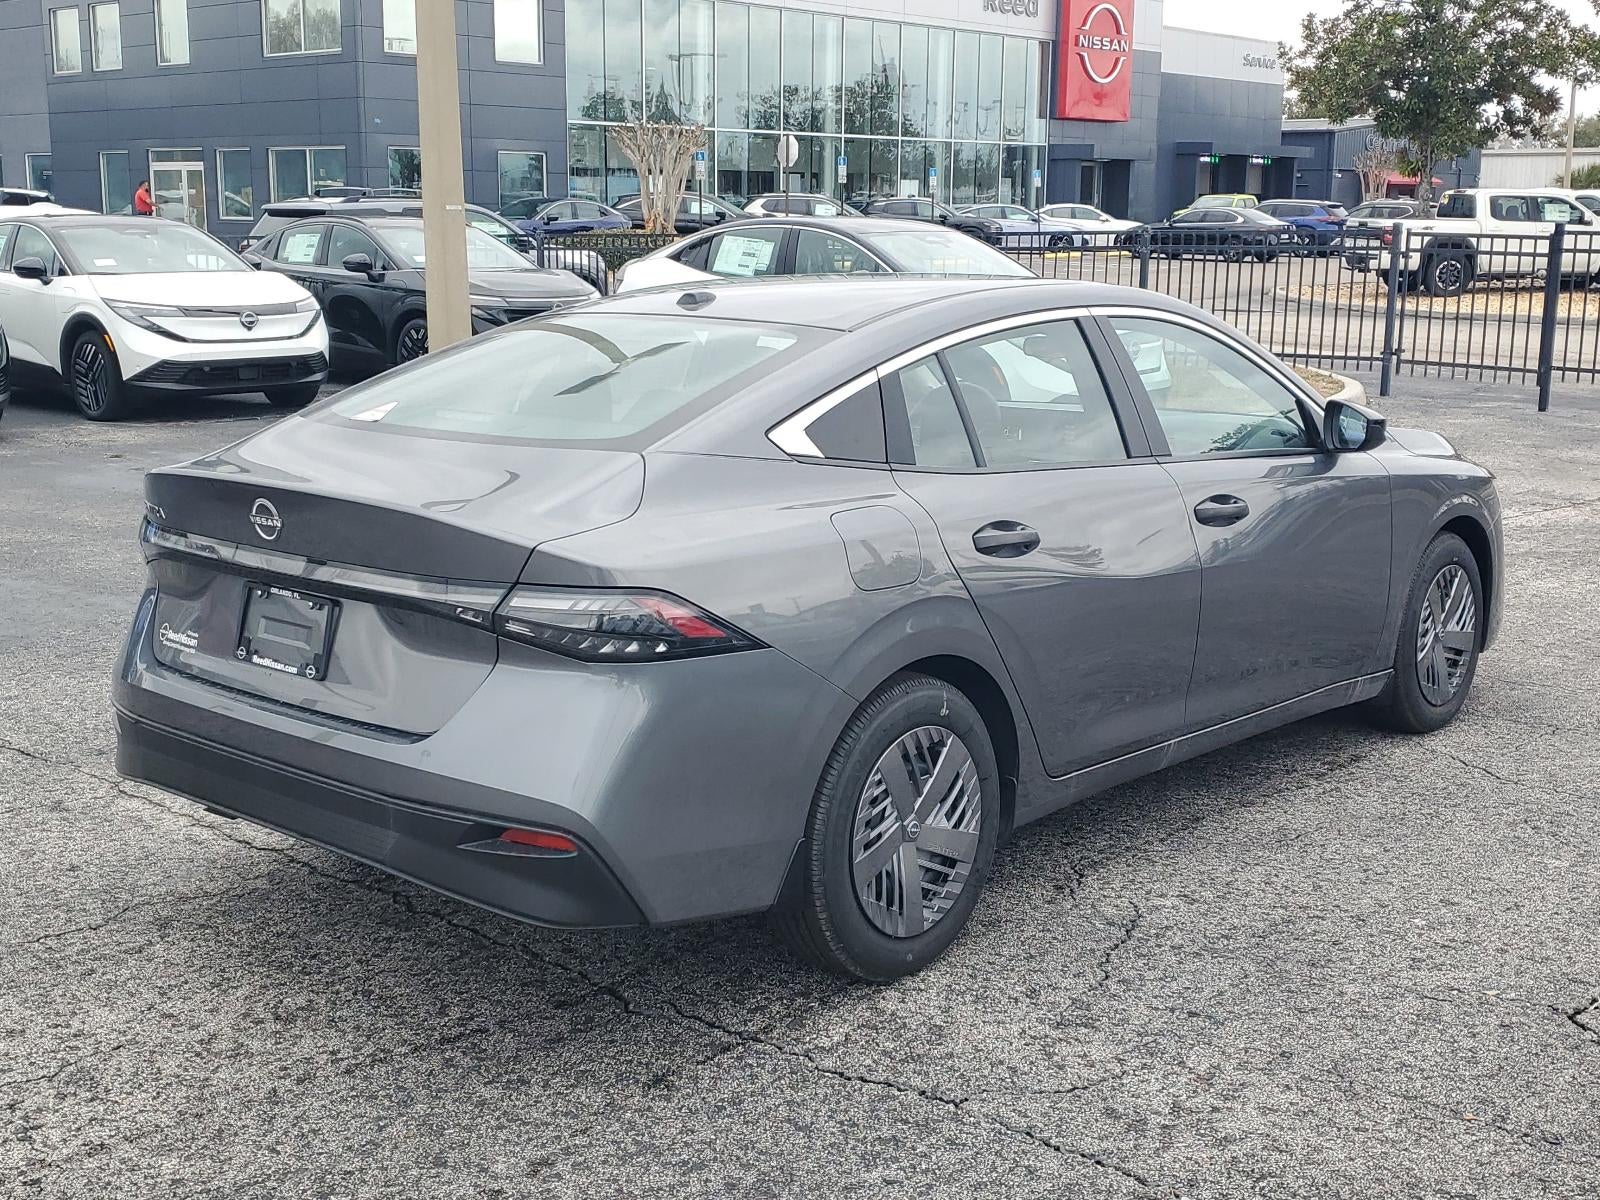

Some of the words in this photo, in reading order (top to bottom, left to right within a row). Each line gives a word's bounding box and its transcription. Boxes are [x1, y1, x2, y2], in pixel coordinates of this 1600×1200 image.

[984, 0, 1039, 17] Reed
[1078, 34, 1130, 52] NISSAN
[1242, 53, 1277, 69] Service
[250, 514, 282, 528] NISSAN
[252, 654, 298, 674] ReedNissan.com
